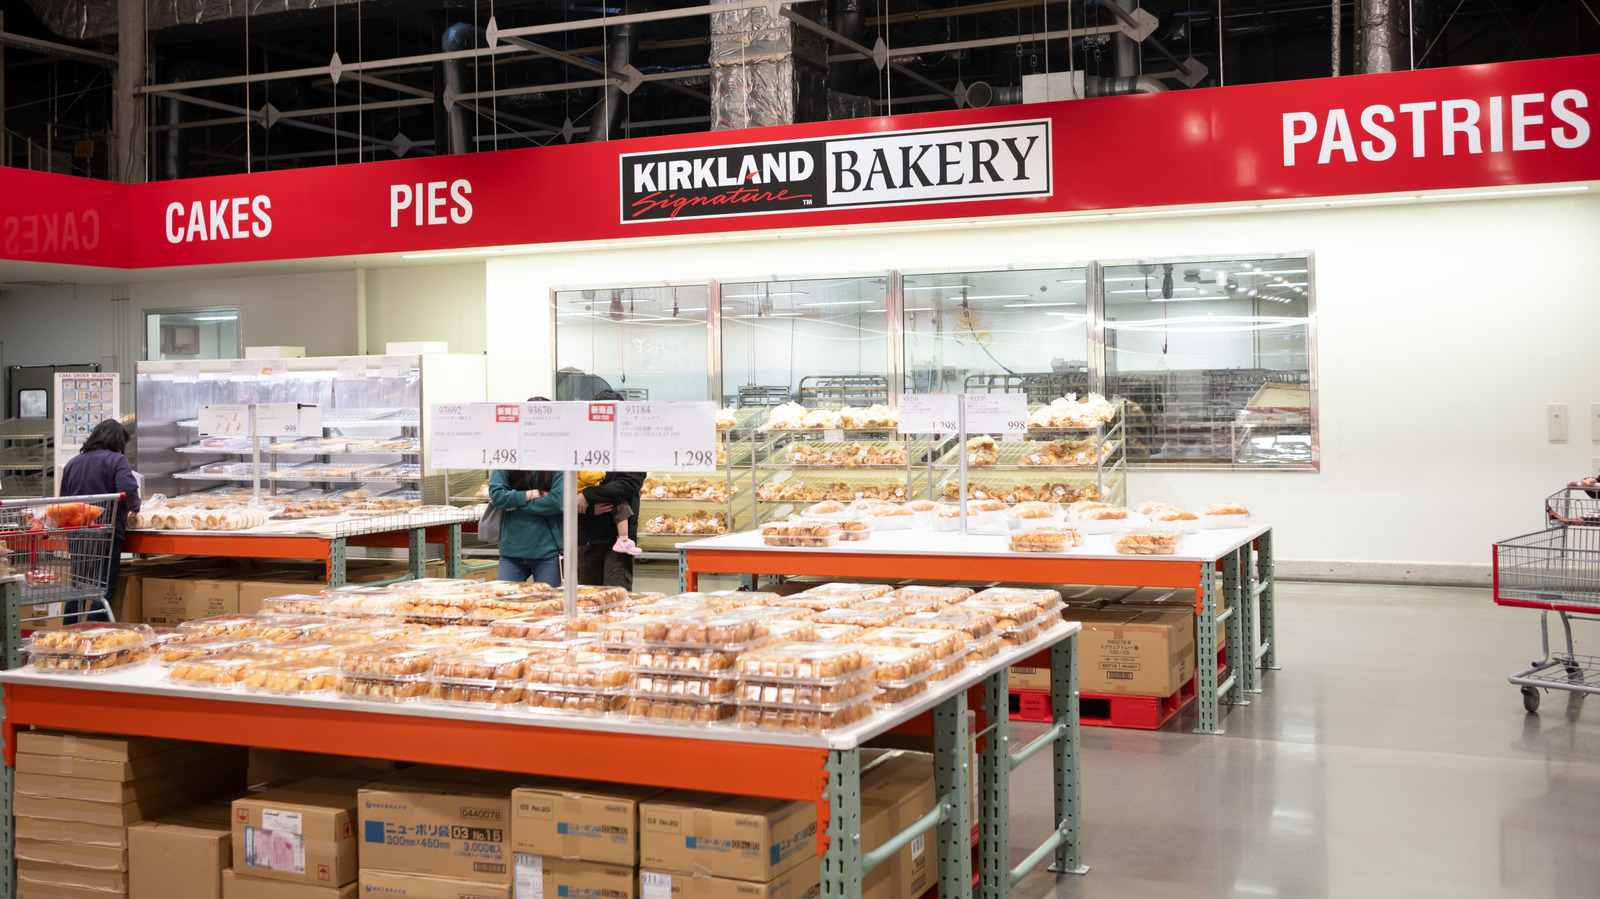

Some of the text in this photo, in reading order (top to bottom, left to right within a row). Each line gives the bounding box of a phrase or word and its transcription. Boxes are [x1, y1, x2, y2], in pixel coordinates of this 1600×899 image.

[1282, 89, 1591, 167] PASTRIES
[633, 150, 815, 194] KIRKLAND
[831, 135, 1039, 193] BAKERY
[390, 179, 473, 228] PIES
[631, 187, 813, 219] Signature
[165, 195, 273, 244] CAKES
[438, 405, 462, 415] 93692
[527, 405, 552, 415] 93670
[590, 405, 614, 415] 新商品
[625, 405, 651, 415] 93184
[284, 424, 297, 433] 998
[1007, 420, 1026, 431] 998
[481, 449, 517, 466] 1,498
[573, 449, 611, 468] 1,498
[673, 450, 713, 469] 1,298
[462, 808, 501, 820] 0440078
[647, 817, 679, 827] 03 No.20
[386, 822, 501, 841] ニューポリ袋 03 No.15
[642, 874, 657, 884] 911
